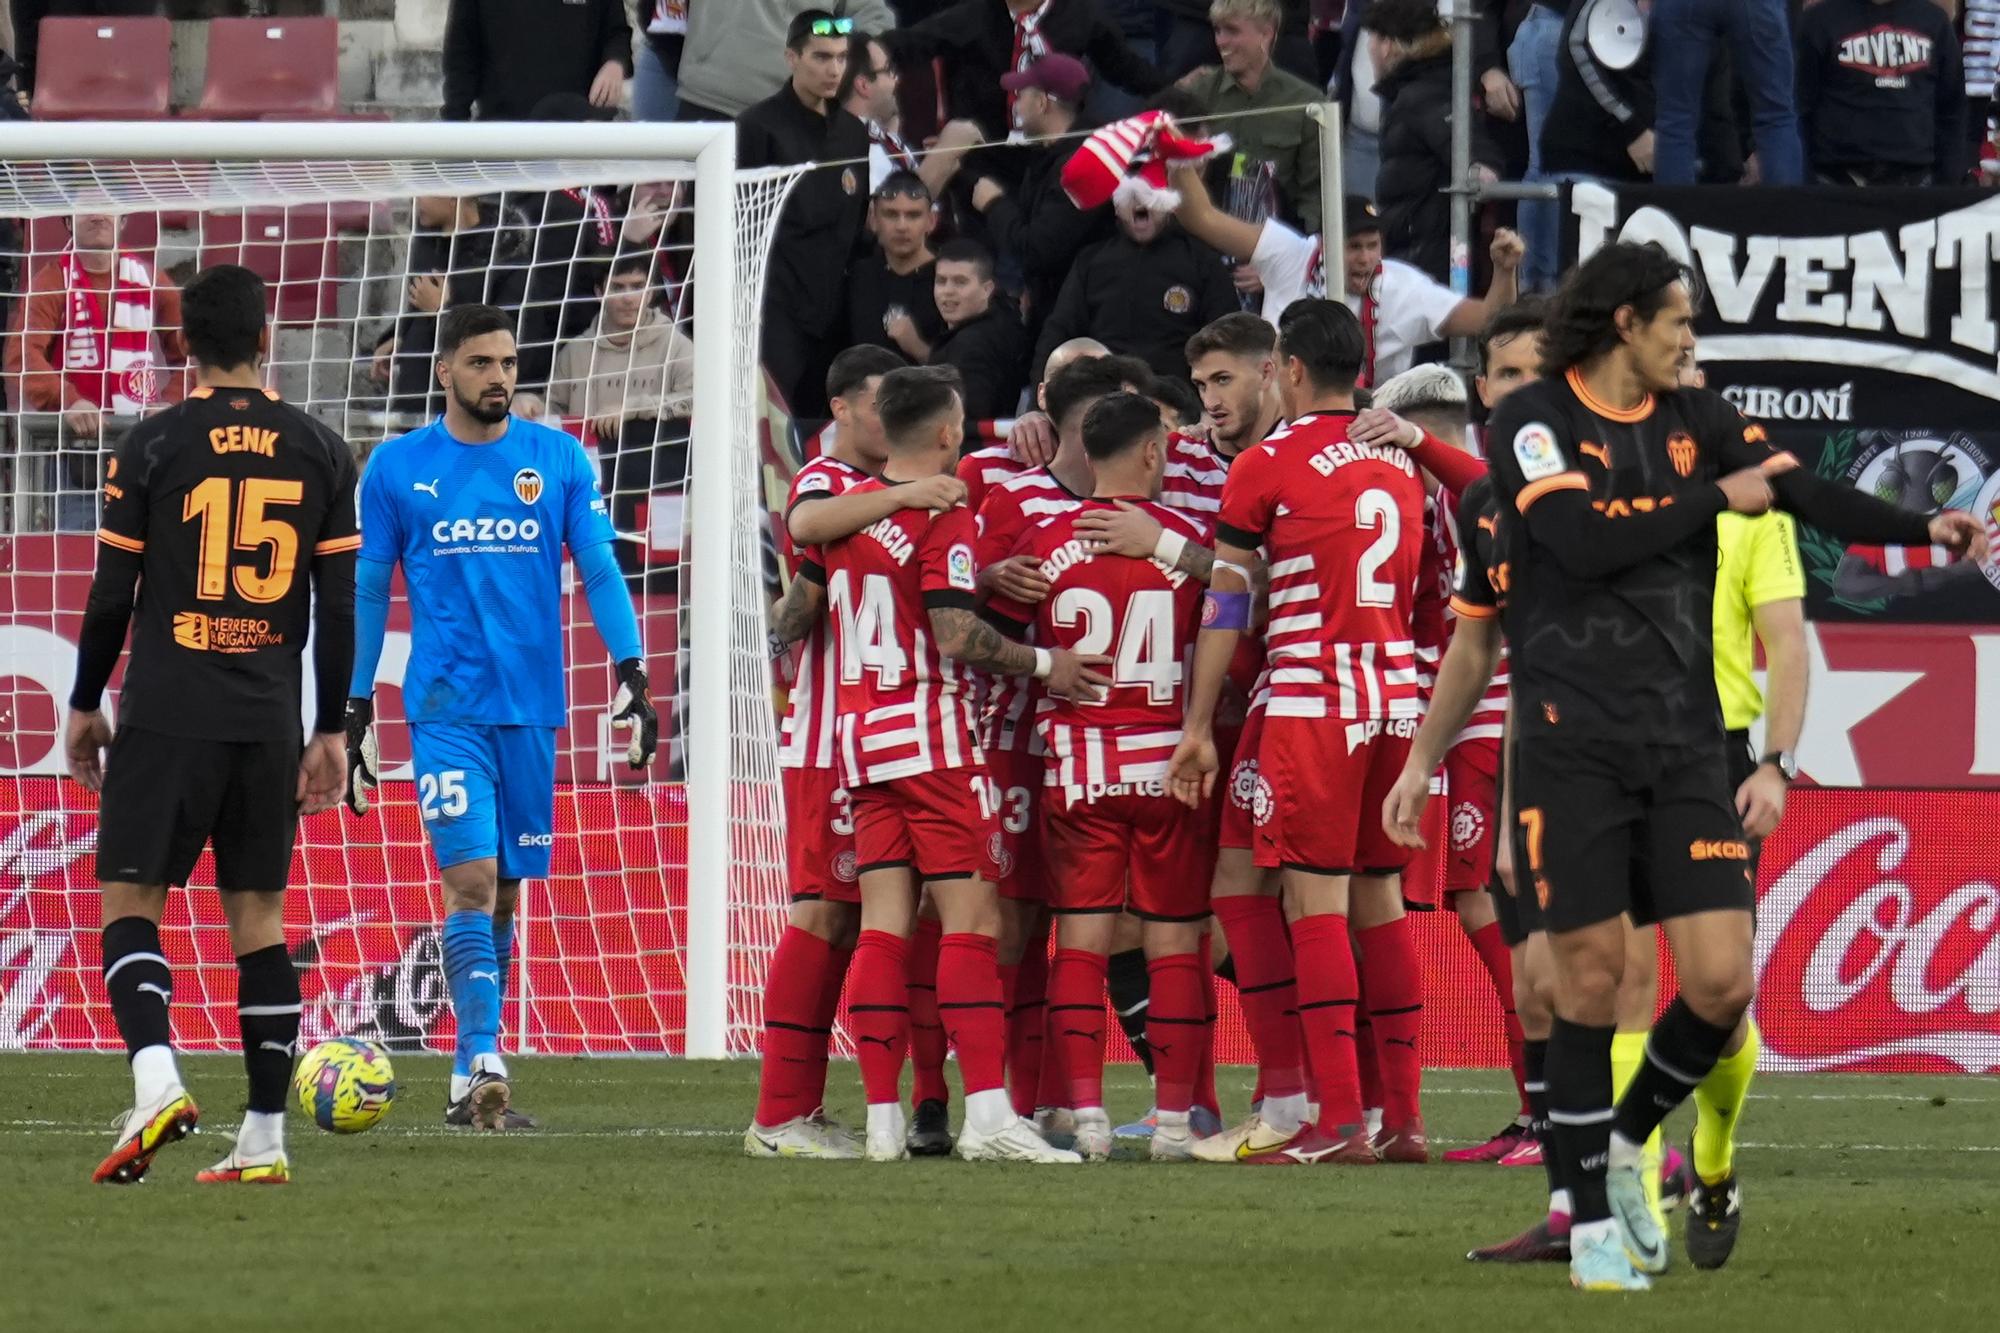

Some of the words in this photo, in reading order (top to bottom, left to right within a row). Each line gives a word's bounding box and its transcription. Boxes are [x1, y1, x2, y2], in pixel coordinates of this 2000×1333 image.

[1838, 31, 1931, 68] JOVENT
[209, 426, 279, 457] CENK
[1308, 441, 1415, 478] BERNARDO
[182, 477, 303, 603] 15
[432, 518, 540, 543] CAZOO
[861, 518, 914, 567] ARCIA
[1355, 488, 1400, 608] 2
[208, 617, 269, 634] HERRERO
[210, 630, 283, 646] BRIGANTINA
[826, 568, 907, 690] 14
[1047, 587, 1182, 706] 24
[419, 771, 468, 821] 25
[1519, 807, 1545, 871] 7
